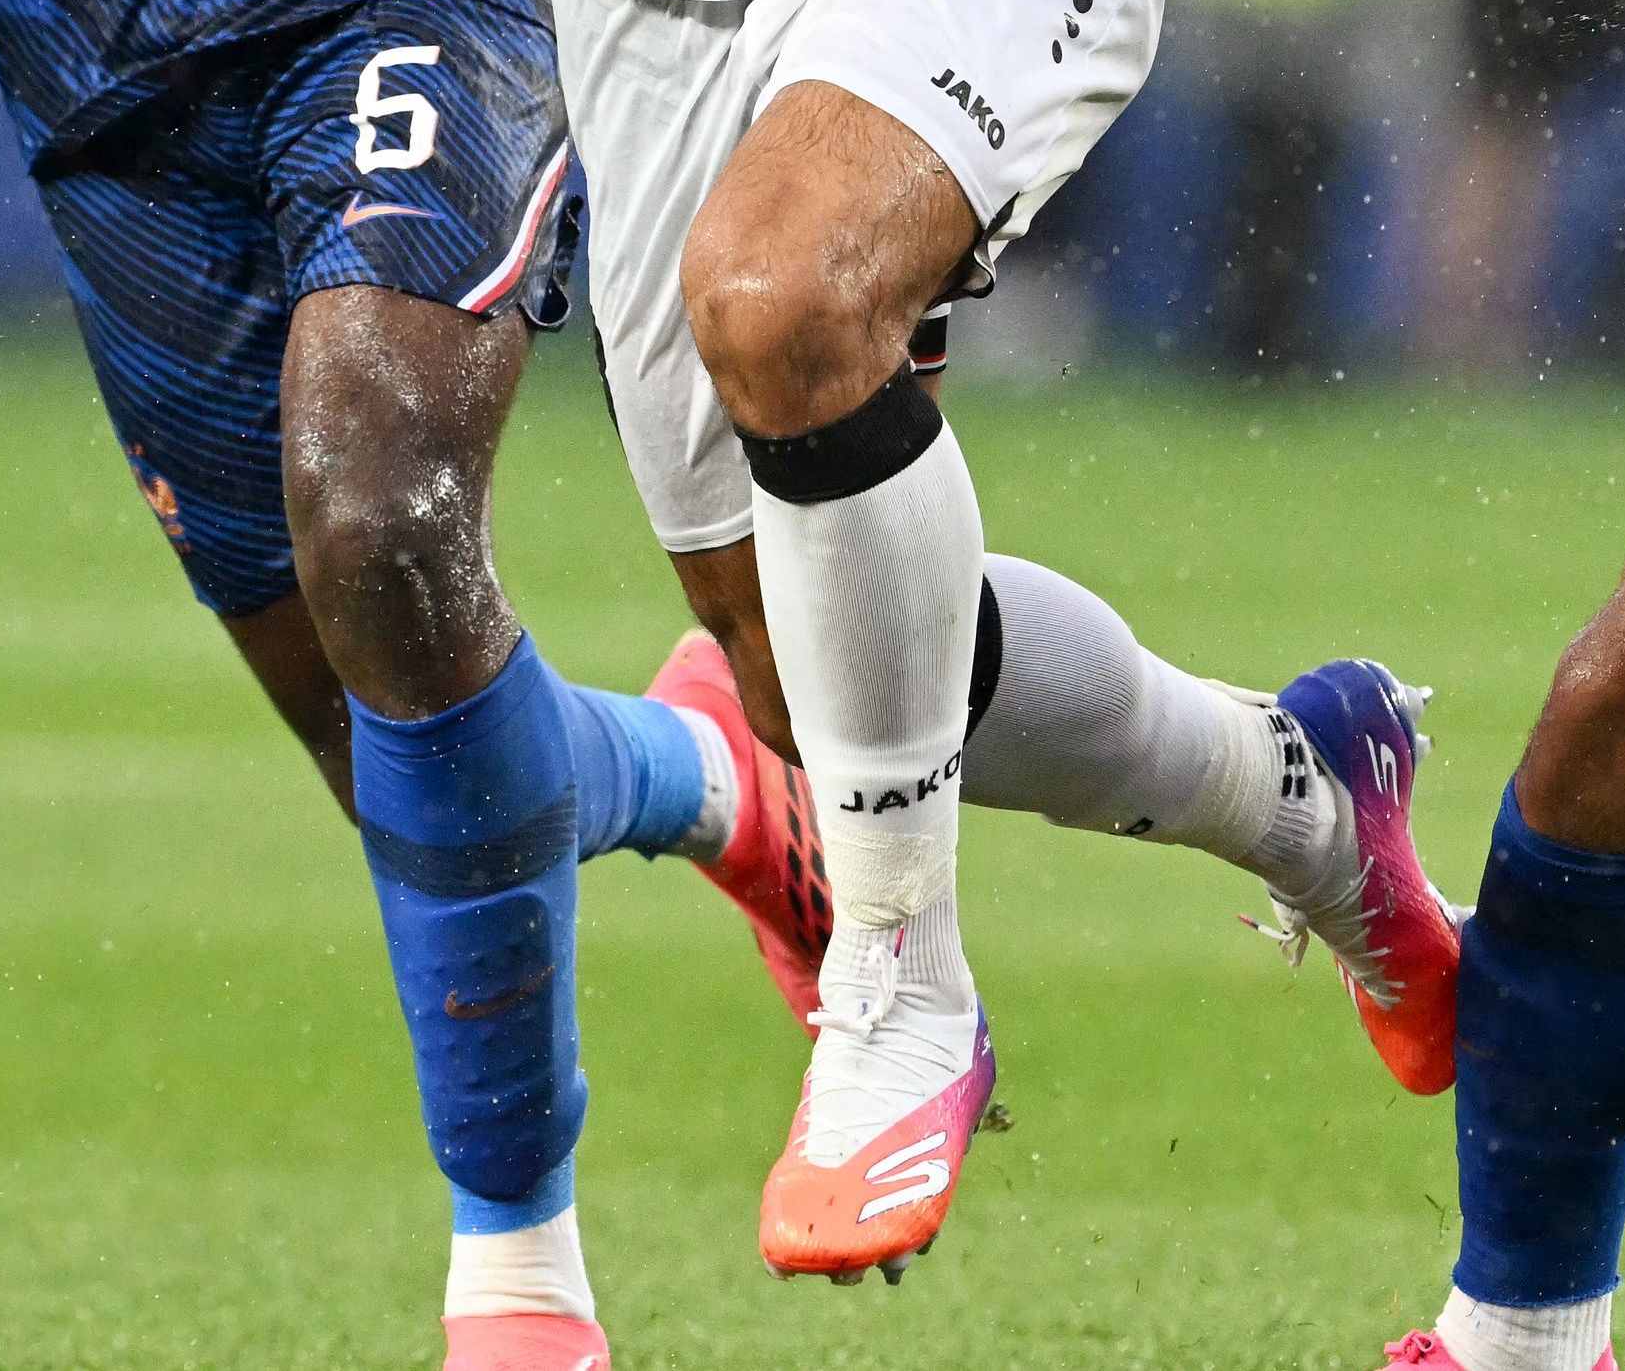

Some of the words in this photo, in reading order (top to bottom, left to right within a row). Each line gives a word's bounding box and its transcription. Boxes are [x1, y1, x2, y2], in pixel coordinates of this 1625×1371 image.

[349, 45, 440, 175] 6
[930, 68, 1005, 150] JAKO
[839, 749, 961, 815] JAKO
